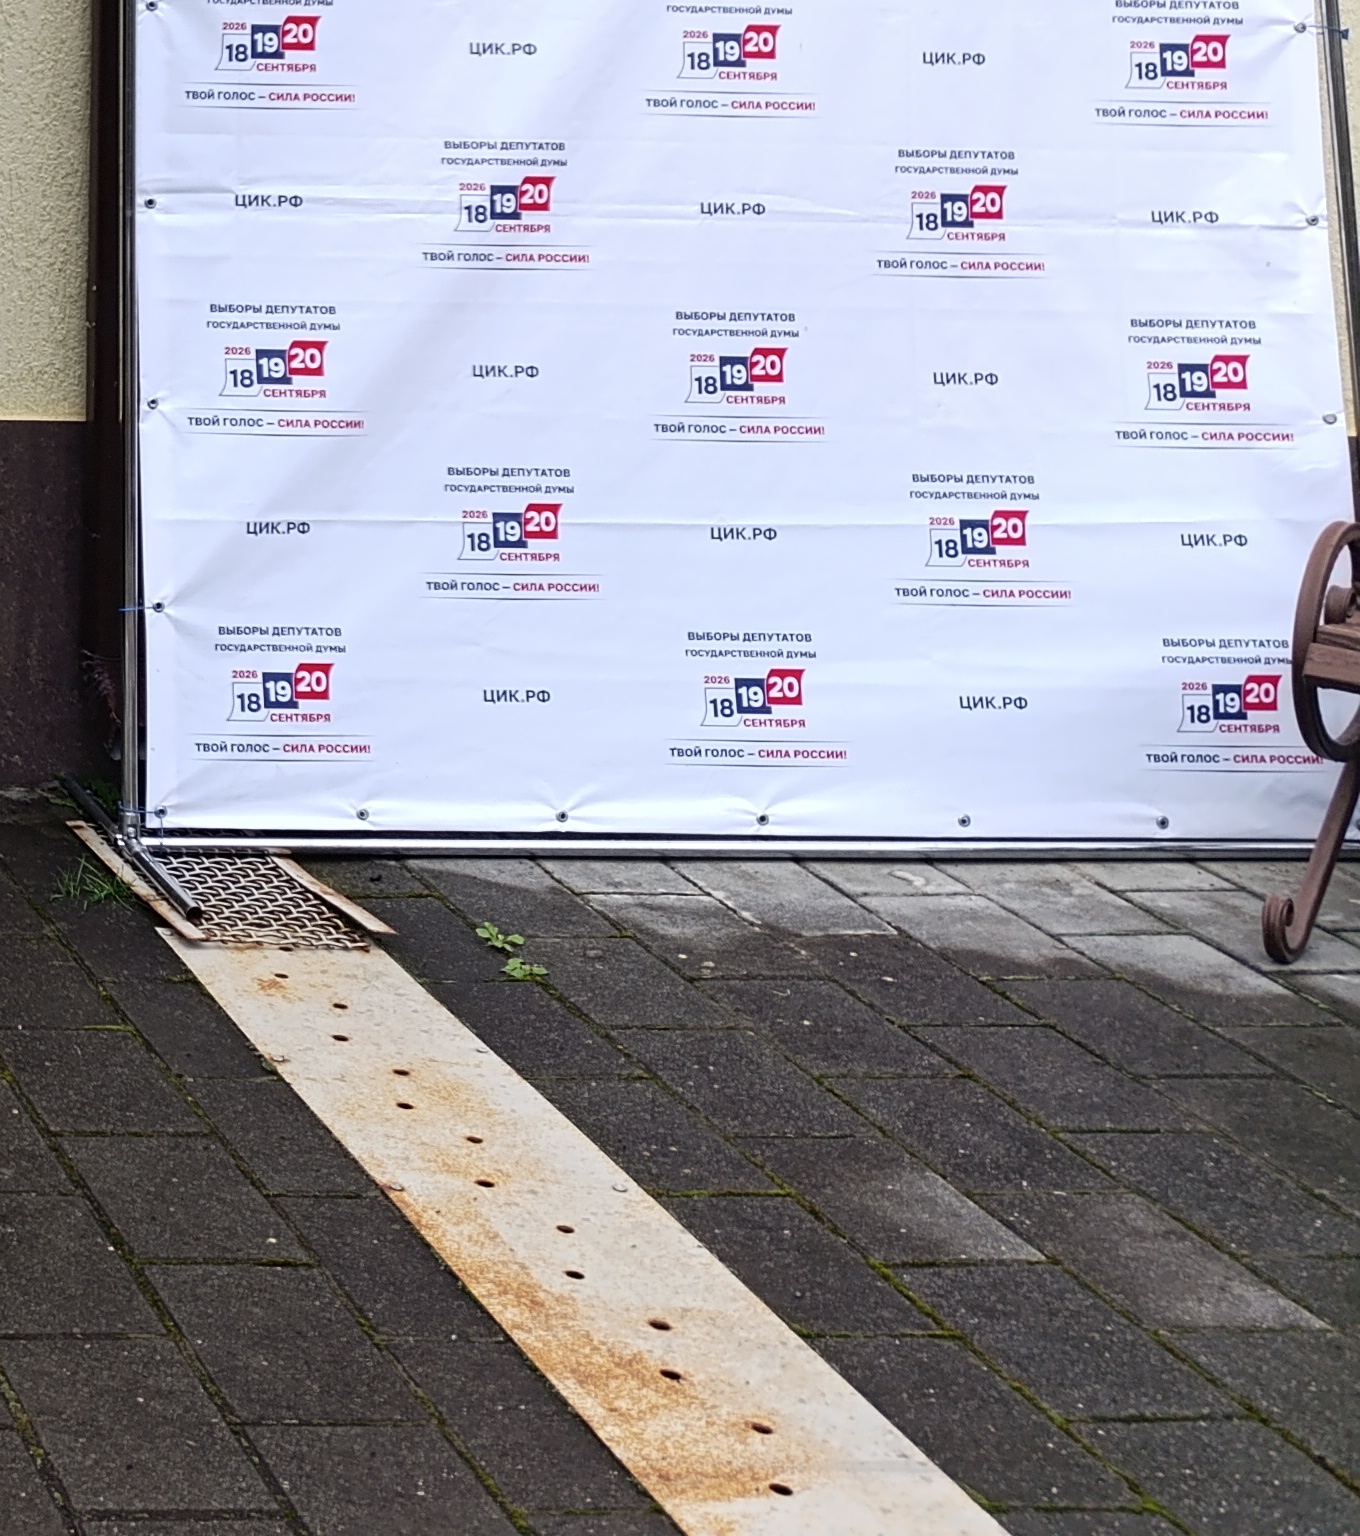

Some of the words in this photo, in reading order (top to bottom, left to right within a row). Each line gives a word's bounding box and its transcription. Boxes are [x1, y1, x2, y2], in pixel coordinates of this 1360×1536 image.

[223, 22, 247, 30] 2026
[226, 44, 248, 62] 18
[254, 33, 278, 52] 19
[284, 23, 313, 43] 20
[470, 43, 537, 56] ЦИК.РФ
[923, 52, 985, 66] ЦИК.РФ
[257, 63, 316, 72] СЕНТЯБРЯ
[185, 89, 214, 99] ТВОЙ
[218, 91, 255, 100] ГОЛОС
[269, 92, 300, 101] СИЛА
[303, 93, 355, 102] РОССИИ!
[898, 149, 947, 158] ВЫБОРЫ
[949, 150, 1015, 160] ДЕПУТАТОВ
[895, 166, 988, 174] ГОСУДАРСТВЕННОЙ
[990, 168, 1018, 176] ДУМЫ
[235, 194, 303, 208] ЦИК.РФ
[911, 191, 936, 199] 2026
[701, 203, 765, 216] ЦИК.РФ
[916, 213, 938, 231] 18
[944, 202, 967, 221] 19
[972, 192, 1000, 212] 20
[1151, 211, 1219, 225] ЦИК.РФ
[947, 232, 1005, 241] СЕНТЯБРЯ
[877, 258, 907, 268] ТВОЙ
[910, 260, 947, 269] ГОЛОС
[961, 261, 991, 270] СИЛА
[994, 262, 1044, 271] РОССИИ!
[210, 304, 262, 313] ВЫБОРЫ
[265, 305, 336, 314] ДЕПУТАТОВ
[207, 321, 307, 330] ГОСУДАРСТВЕННОЙ
[309, 323, 340, 331] ДУМЫ
[1131, 319, 1182, 328] ВЫБОРЫ
[1186, 320, 1256, 329] ДЕПУТАТОВ
[1128, 335, 1227, 344] ГОСУДАРСТВЕННОЙ
[1230, 337, 1261, 345] ДУМЫ
[225, 347, 251, 355] 2026
[230, 369, 254, 388] 18
[259, 358, 285, 378] 19
[290, 348, 321, 368] 20
[1147, 361, 1173, 369] 2026
[473, 365, 539, 378] ЦИК.РФ
[934, 372, 998, 386] ЦИК.РФ
[1153, 383, 1177, 401] 18
[1181, 371, 1208, 392] 19
[1213, 362, 1244, 382] 20
[263, 389, 326, 398] СЕНТЯБРЯ
[1186, 402, 1250, 411] СЕНТЯБРЯ
[188, 415, 220, 426] ТВОЙ
[223, 418, 263, 427] ГОЛОС
[278, 419, 311, 428] СИЛА
[314, 420, 366, 429] РОССИИ!
[1115, 429, 1147, 439] ТВОЙ
[1150, 431, 1188, 440] ГОЛОС
[1202, 432, 1234, 440] СИЛА
[1238, 432, 1293, 441] РОССИИ!
[448, 467, 499, 476] ВЫБОРЫ
[502, 468, 570, 477] ДЕПУТАТОВ
[445, 484, 542, 493] ГОСУДАРСТВЕННОЙ
[544, 486, 574, 494] ДУМЫ
[462, 510, 488, 518] 2026
[247, 522, 310, 536] ЦИК.РФ
[467, 533, 491, 552] 18
[496, 521, 520, 541] 19
[526, 511, 556, 531] 20
[711, 527, 777, 541] ЦИК.РФ
[1181, 534, 1247, 548] ЦИК.РФ
[500, 553, 560, 561] СЕНТЯБРЯ
[426, 580, 458, 590] ТВОЙ
[461, 582, 499, 591] ГОЛОС
[513, 583, 545, 591] СИЛА
[548, 583, 599, 592] РОССИИ!
[688, 632, 739, 641] ВЫБОРЫ
[743, 633, 812, 642] ДЕПУТАТОВ
[685, 649, 784, 658] ГОСУДАРСТВЕННОЙ
[786, 651, 816, 659] ДУМЫ
[704, 676, 730, 684] 2026
[484, 690, 550, 703] ЦИК.РФ
[710, 699, 734, 717] 18
[738, 687, 763, 707] 19
[769, 677, 799, 697] 20
[960, 696, 1027, 710] ЦИК.РФ
[744, 719, 805, 728] СЕНТЯБРЯ
[669, 746, 701, 757] ТВОЙ
[705, 749, 744, 758] ГОЛОС
[758, 750, 790, 758] СИЛА
[794, 750, 846, 759] РОССИИ!
